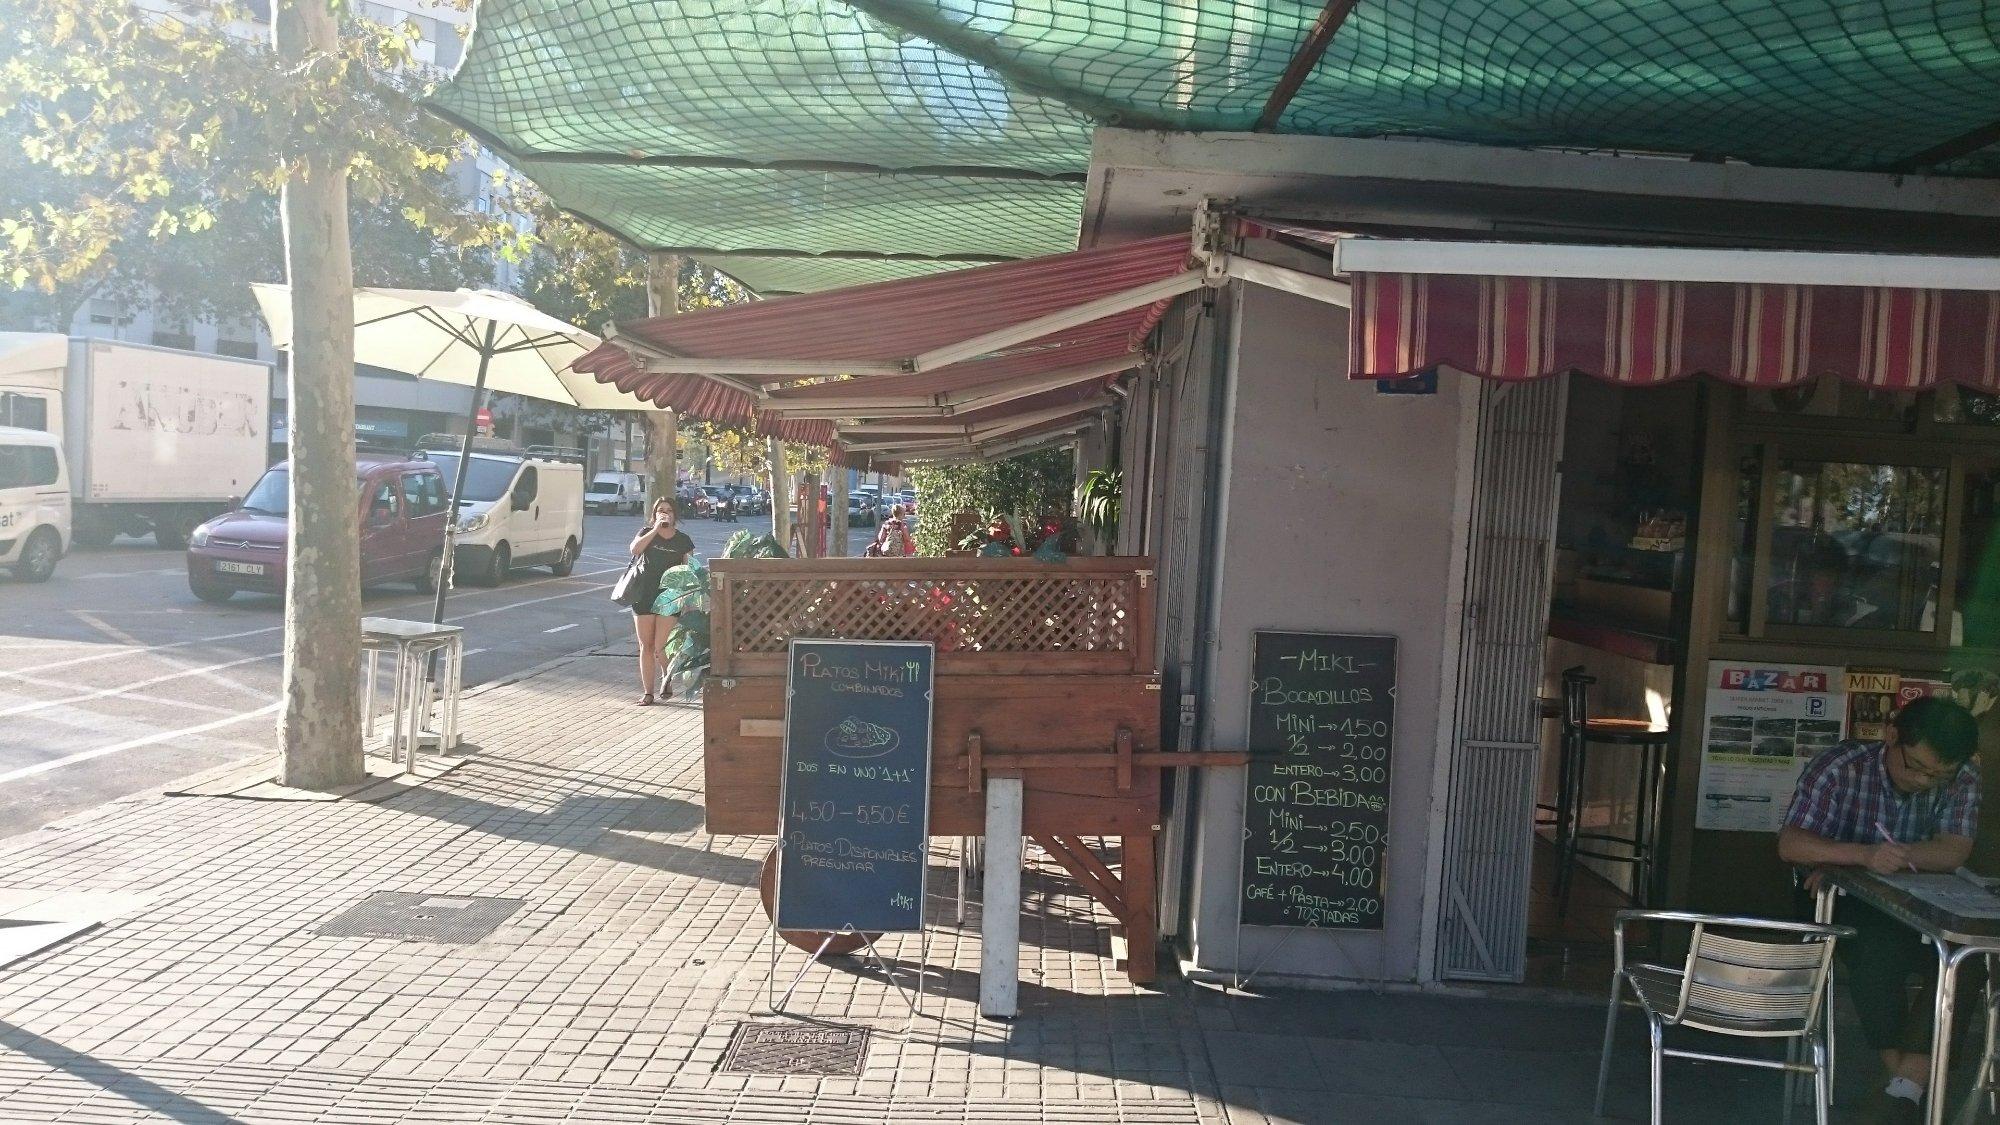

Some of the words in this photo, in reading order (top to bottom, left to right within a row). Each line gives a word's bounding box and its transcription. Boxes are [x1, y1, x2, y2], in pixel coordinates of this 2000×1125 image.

[831, 681, 904, 697] COMBINADOS
[1729, 671, 1819, 690] BAZAR
[1850, 675, 1892, 691] MINI
[1261, 677, 1372, 705] BOCADILLOS
[1340, 743, 1386, 760] 2,00
[828, 764, 847, 774] EN
[853, 766, 876, 780] UNO
[1273, 764, 1323, 777] ENTERO
[1342, 765, 1386, 783] 3,00
[1255, 785, 1285, 802] CON
[1330, 821, 1379, 843] 2,50
[1331, 840, 1375, 867] 3,00
[801, 855, 875, 873] PREGUNTAR
[1256, 856, 1313, 878] ENTERO
[1331, 864, 1374, 888] 4,00
[1295, 906, 1359, 923] TOSTADAS
[1347, 898, 1379, 914] 2,00
